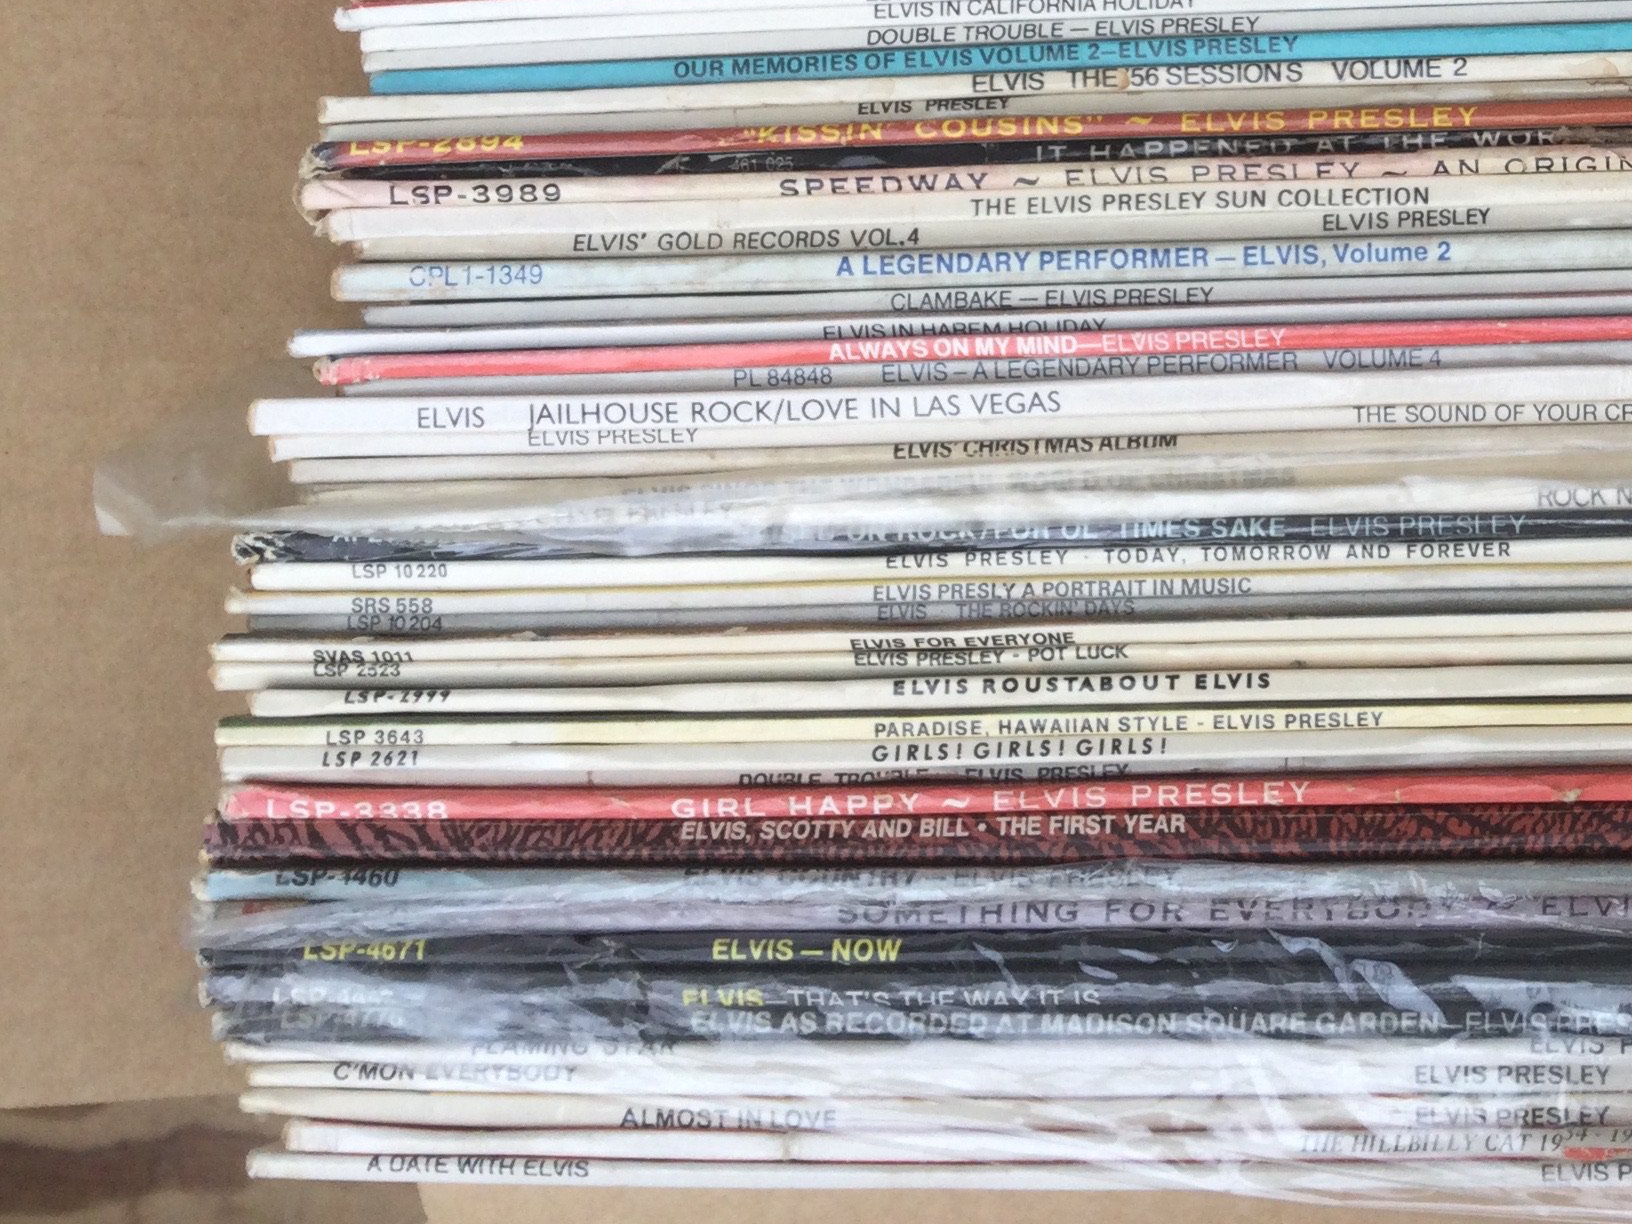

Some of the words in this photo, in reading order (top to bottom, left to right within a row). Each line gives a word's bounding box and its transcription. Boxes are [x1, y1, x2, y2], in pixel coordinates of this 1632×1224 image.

[867, 26, 956, 46] DOUBLE
[961, 21, 1064, 42] TROUBLE
[1095, 18, 1154, 36] ELVIS
[1161, 16, 1260, 34] PRESLEY
[674, 60, 724, 79] OUR
[731, 53, 858, 75] MEMORIES
[865, 51, 896, 71] OF
[904, 48, 973, 68] ELVIS
[978, 43, 1077, 65] VOLUME
[1166, 63, 1302, 84] SESSIONS
[1454, 59, 1467, 78] 2
[1182, 110, 1286, 132] ELVIS
[1308, 106, 1479, 129] PRESLEY
[389, 183, 561, 205] LSP-3989
[971, 197, 1021, 216] THE
[1027, 196, 1092, 213] ELVIS
[1101, 192, 1205, 211] PRESLEY
[1216, 190, 1266, 209] SUN
[1277, 186, 1429, 207] COLLECTION
[1323, 212, 1389, 232] ELVIS
[1399, 208, 1491, 228] PRESLEY
[657, 232, 723, 251] GOLD
[733, 230, 839, 248] RECORDS
[836, 257, 854, 276] A
[862, 252, 1032, 274] LEGENDARY
[1039, 247, 1209, 270] PERFORMER
[1333, 242, 1428, 264] Volume
[1437, 241, 1452, 261] 2
[829, 340, 928, 360] ALWAYS
[934, 339, 970, 357] ON
[975, 338, 1009, 356] MY
[1176, 329, 1286, 349] PRESLEY
[1430, 349, 1441, 366] 4
[767, 367, 833, 385] 84848
[417, 407, 485, 428] ELVIS
[527, 403, 678, 430] JAILHOUSE
[692, 396, 859, 424] ROCK/LOVE
[871, 396, 901, 418] IN
[914, 394, 960, 416] LAS
[970, 392, 1061, 415] VEGAS
[1354, 406, 1396, 423] THE
[1405, 404, 1486, 423] SOUND
[1495, 404, 1525, 421] OF
[1533, 404, 1598, 421] YOUR
[1201, 544, 1331, 562] TOMORROW
[1346, 543, 1390, 559] AND
[1406, 542, 1511, 559] FOREVER
[1181, 578, 1251, 595] MUSIC
[352, 598, 390, 613] SRS
[396, 598, 432, 613] 558
[1119, 716, 1187, 733] STYLE
[1213, 714, 1277, 731] ELVIS
[1285, 711, 1383, 729] PRESLEY
[992, 787, 1105, 811] ELVIS
[760, 818, 855, 840] SCOTTY
[862, 817, 911, 838] AND
[919, 816, 968, 837] BILL
[997, 816, 1044, 836] THE
[1049, 815, 1116, 836] FIRST
[1123, 814, 1185, 834] YEAR
[711, 940, 793, 962] ELVIS
[831, 938, 902, 962] NOW
